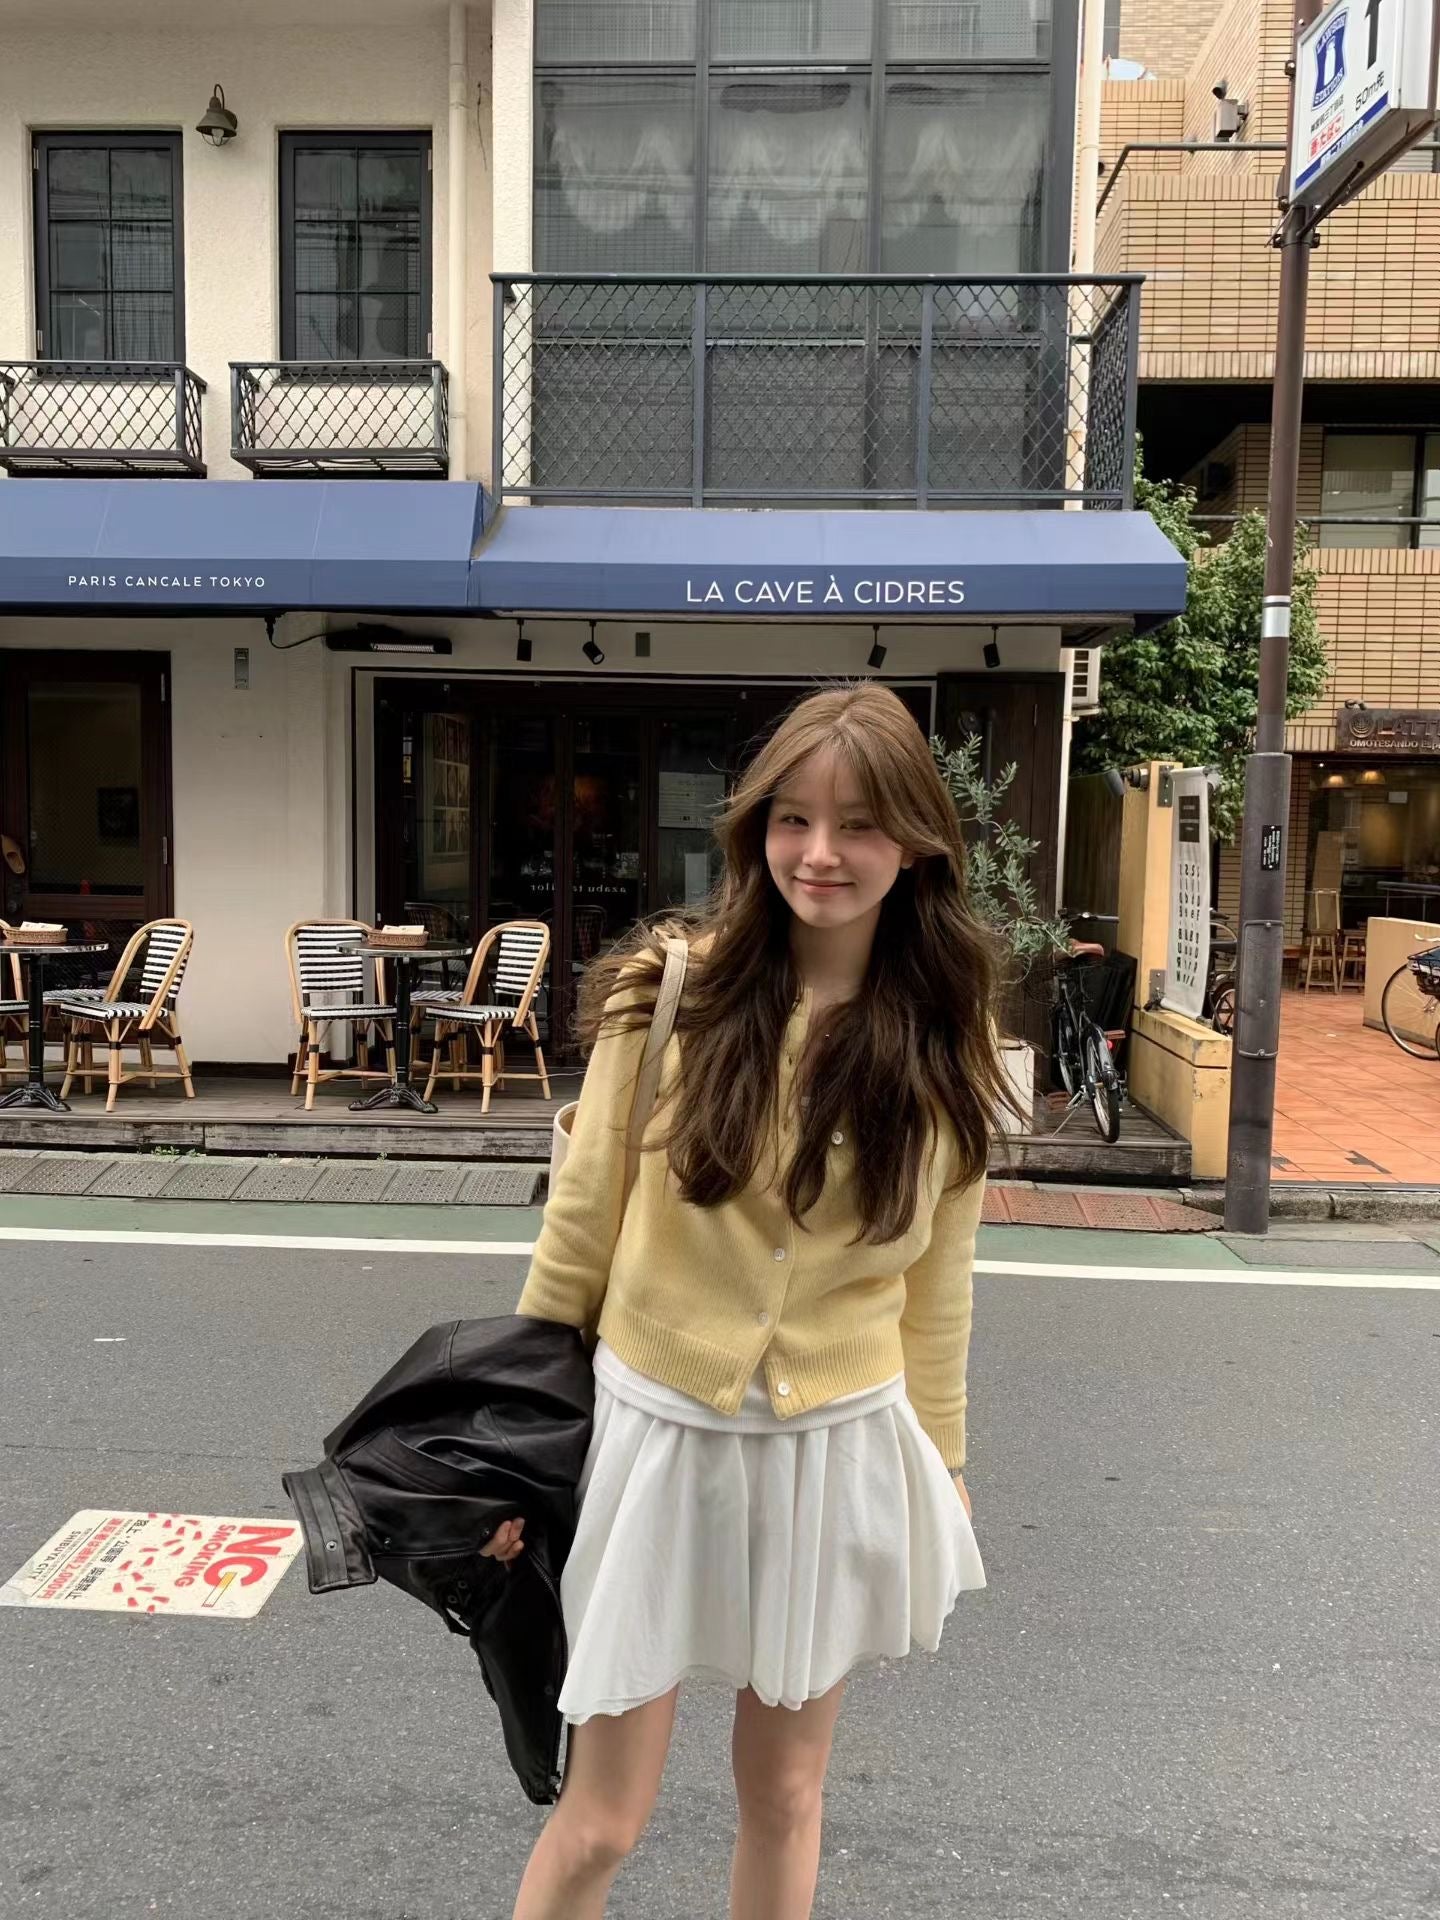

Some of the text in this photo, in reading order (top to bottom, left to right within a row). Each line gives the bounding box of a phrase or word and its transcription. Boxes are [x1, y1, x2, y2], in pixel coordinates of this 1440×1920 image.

[68, 575, 265, 588] PARIS CANCALE TOKYO
[687, 574, 965, 604] LA CAVE À CIDRES
[1377, 717, 1440, 735] LATT
[1349, 739, 1419, 749] OMOTESANDO
[44, 1530, 82, 1562] SHIBUYA
[174, 1524, 237, 1588] SMOKING
[28, 1562, 49, 1580] CITY
